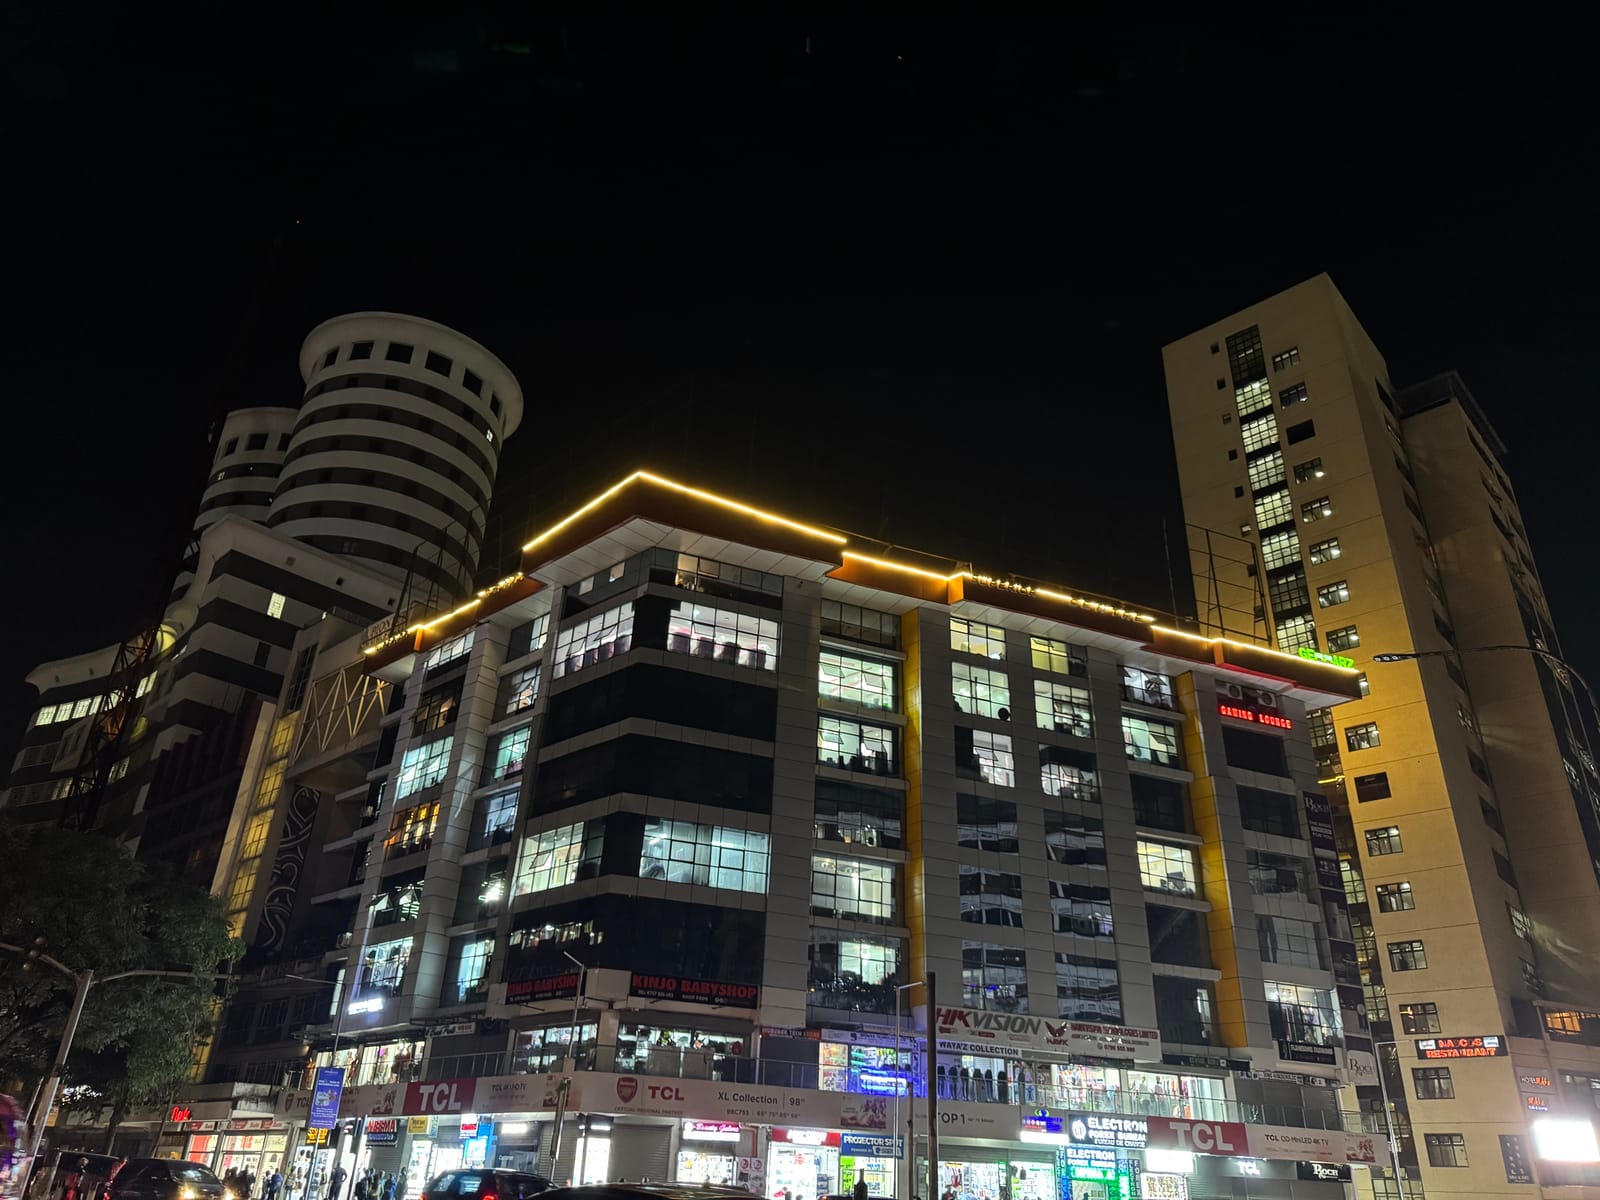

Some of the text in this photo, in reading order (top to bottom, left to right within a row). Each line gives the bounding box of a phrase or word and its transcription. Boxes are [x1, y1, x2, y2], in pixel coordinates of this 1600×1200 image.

[1219, 705, 1293, 729] GAMING LOUNGE
[632, 975, 677, 991] KINJO
[680, 980, 757, 999] BABYSHOP
[937, 1007, 1042, 1035] HIKVISION
[969, 1043, 1019, 1056] COLLECTION
[1437, 1038, 1483, 1048] NACS
[1425, 1048, 1496, 1059] RESTAURANT
[419, 1082, 463, 1112] TCL
[647, 1085, 685, 1101] TCL
[717, 1091, 806, 1107] XL Collection 98"
[1087, 1117, 1148, 1133] ELECTRON
[843, 1135, 884, 1146] PROJECTOR
[1124, 1140, 1146, 1148] CHANGE
[1169, 1121, 1234, 1151] TCL
[1264, 1134, 1280, 1142] TCL
[1067, 1149, 1116, 1161] ELECTRON
[1238, 1160, 1261, 1176] TCL
